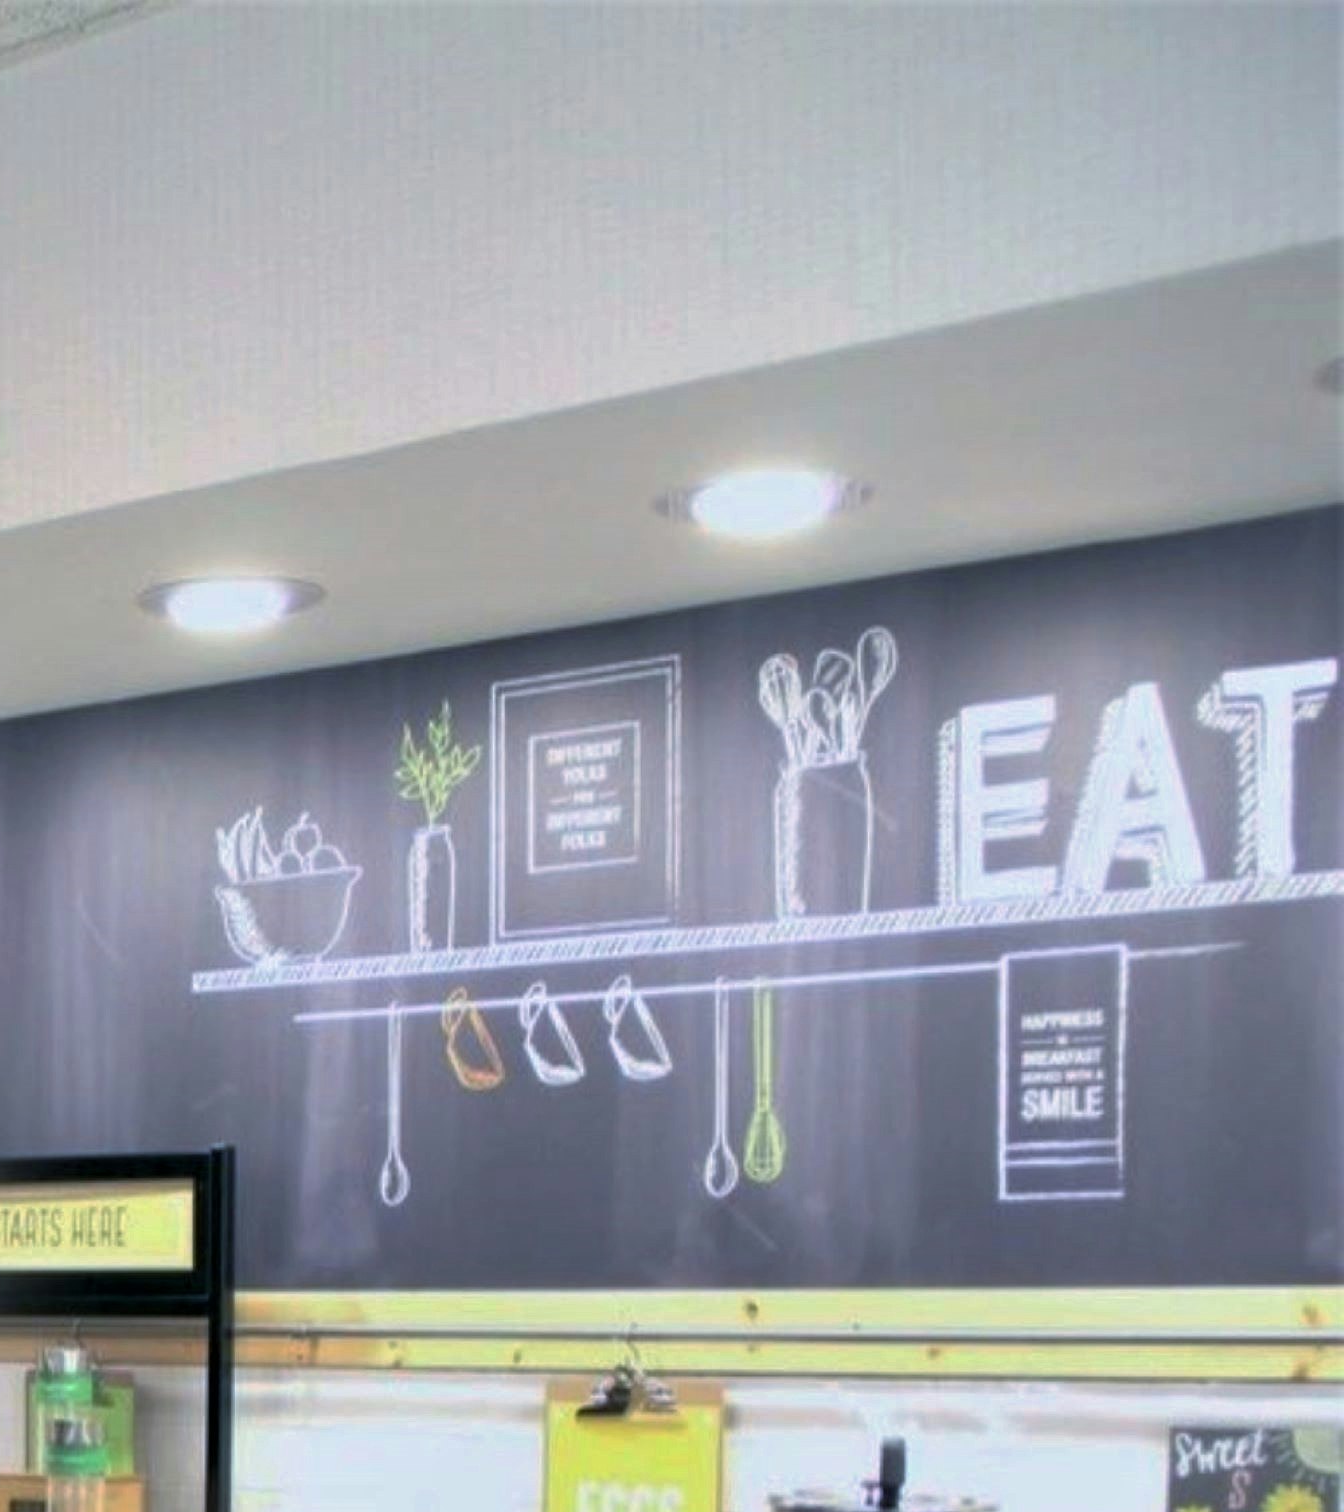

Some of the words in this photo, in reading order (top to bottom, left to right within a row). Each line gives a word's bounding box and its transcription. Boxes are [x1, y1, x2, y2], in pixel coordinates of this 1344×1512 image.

[938, 657, 1338, 905] EAT
[1020, 1010, 1104, 1030] HAPPINESS
[1020, 1047, 1103, 1066] BREAKFAST
[1020, 1085, 1104, 1121] SMILE
[71, 1205, 128, 1247] HERE
[1175, 1430, 1267, 1477] Sweet
